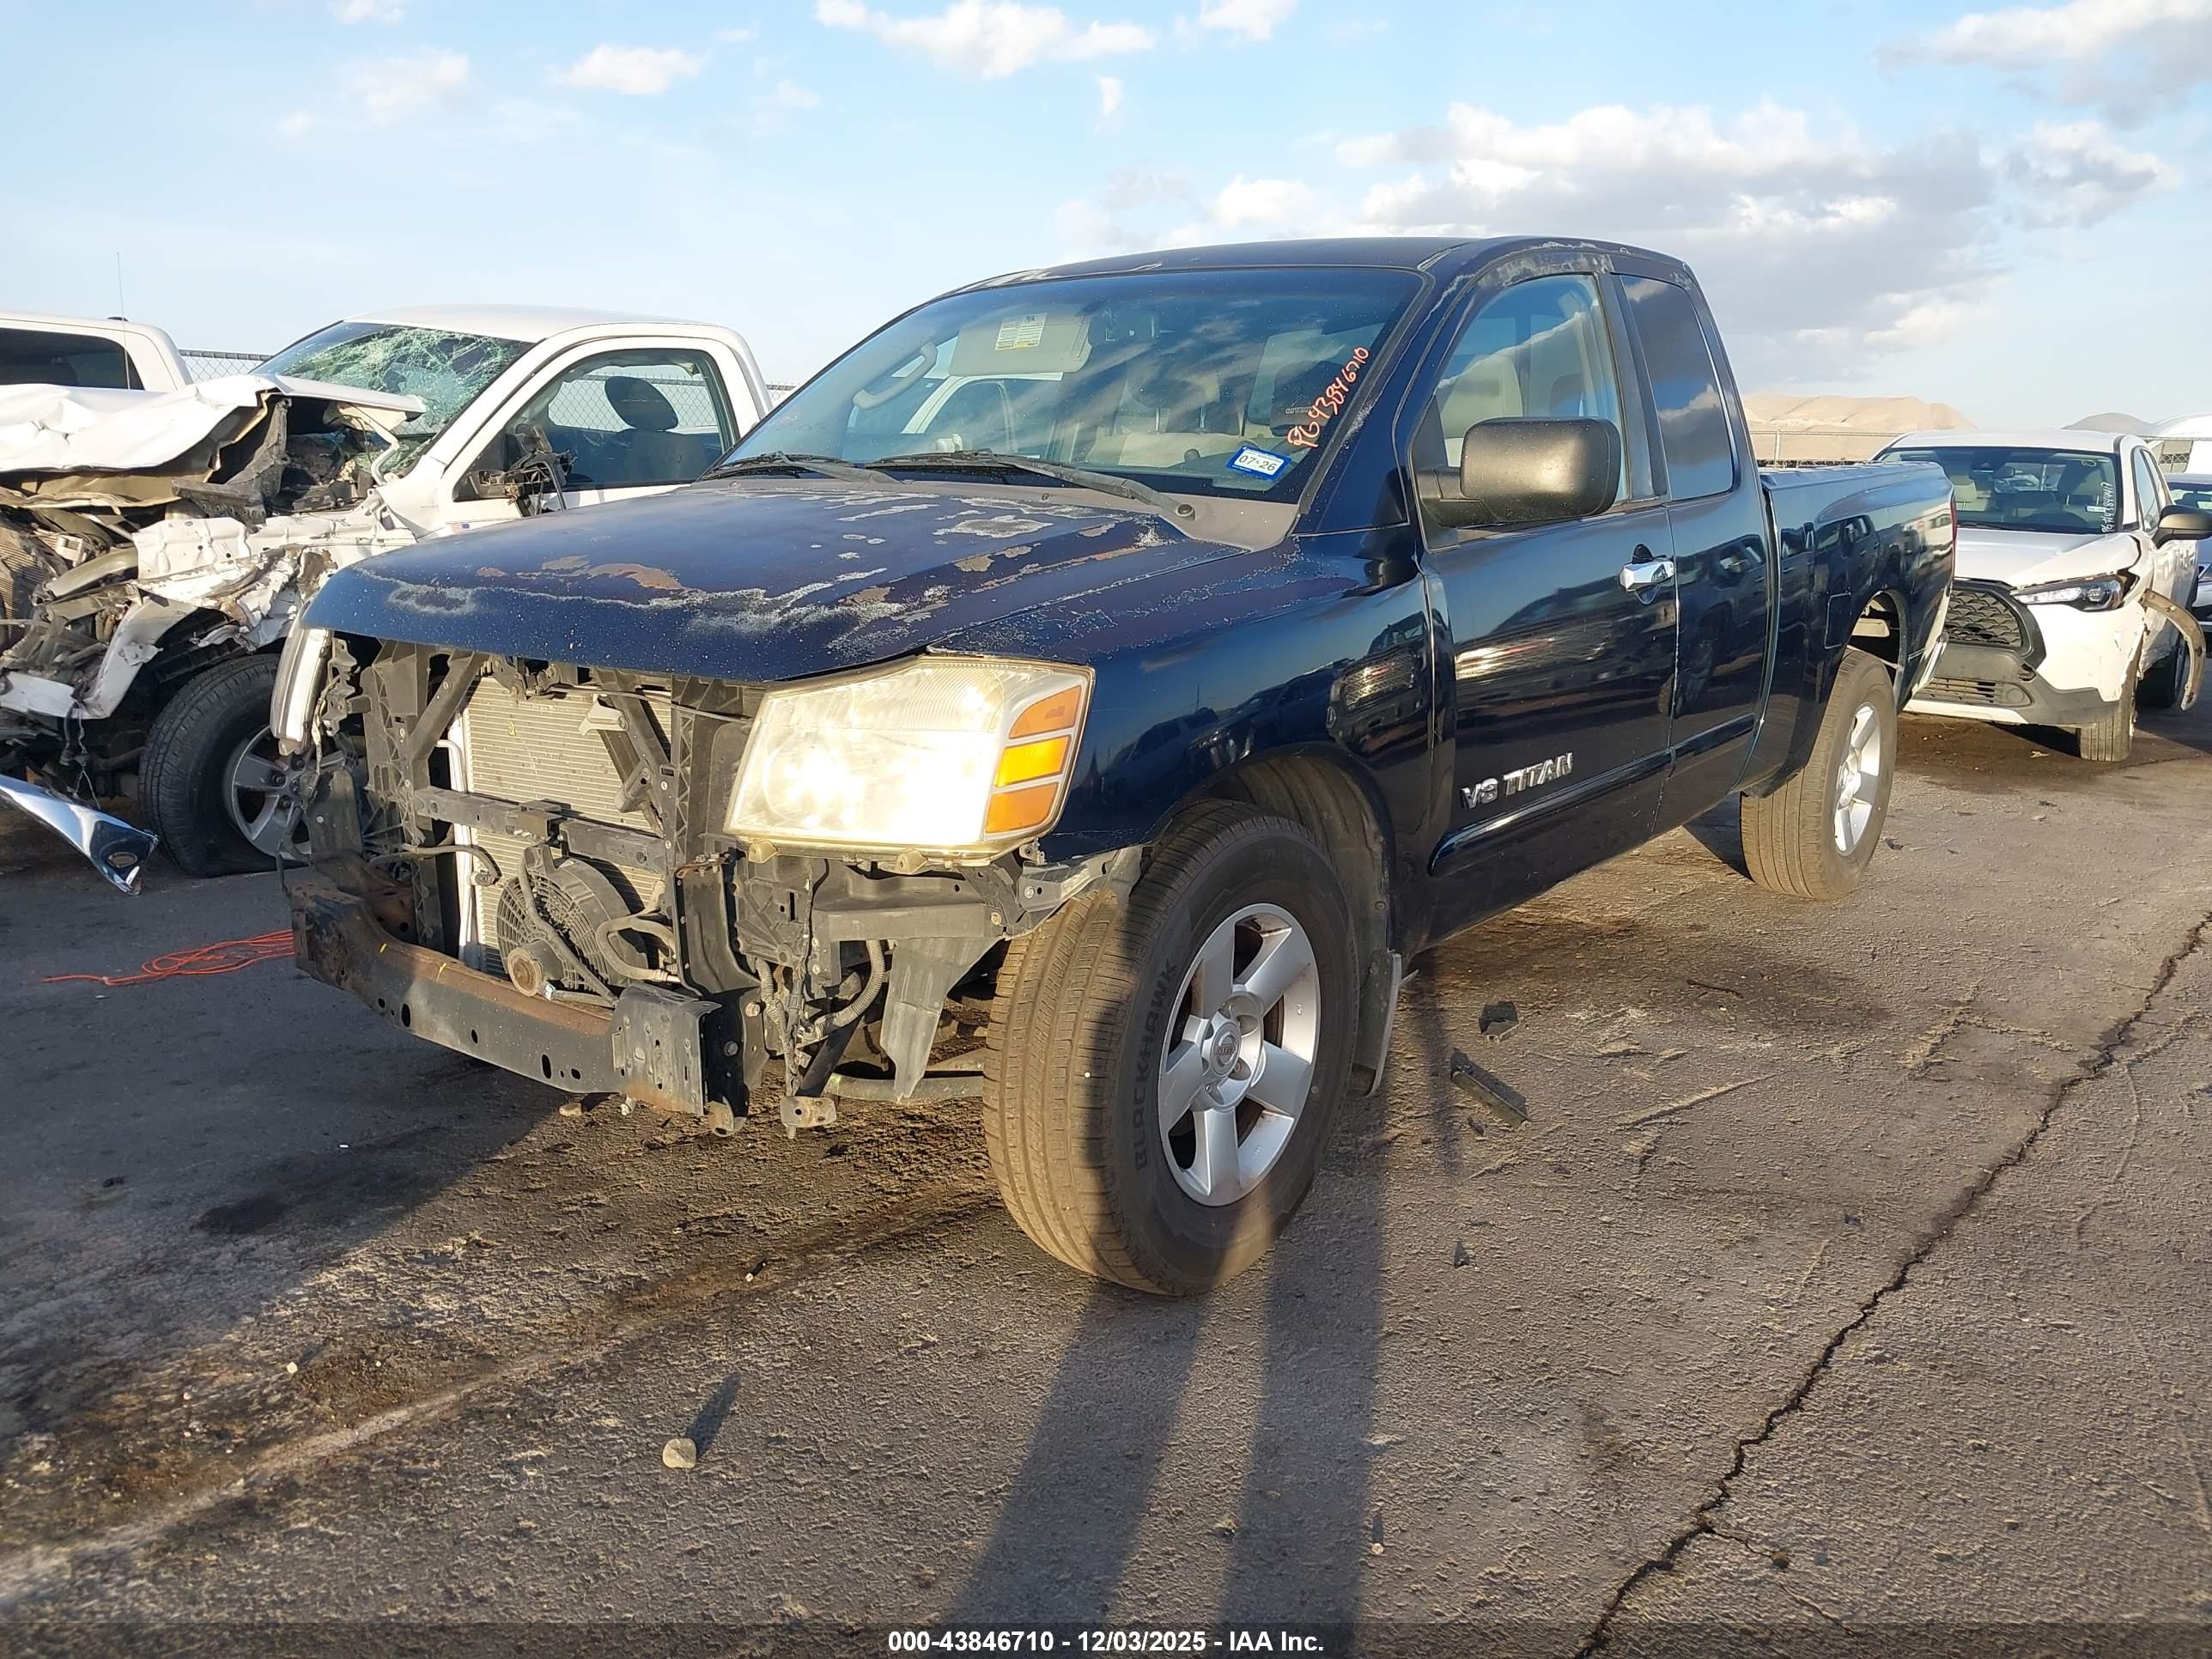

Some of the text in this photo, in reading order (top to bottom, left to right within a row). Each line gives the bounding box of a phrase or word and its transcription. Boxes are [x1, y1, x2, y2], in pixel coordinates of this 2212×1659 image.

[1238, 455, 1256, 465] 07
[1258, 460, 1278, 471] 26
[1460, 751, 1573, 810] V8 TITAN
[1133, 960, 1177, 1170] BLACKHAWK
